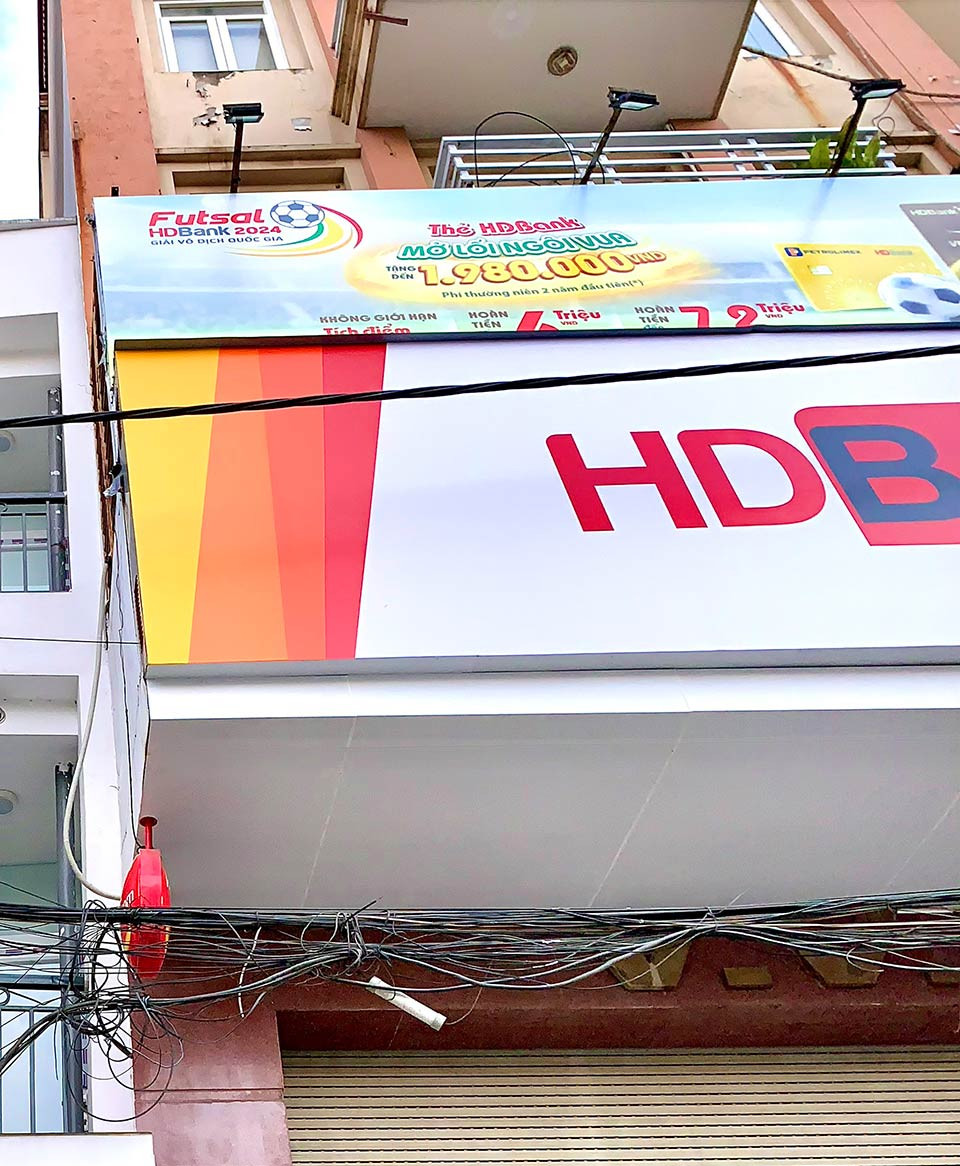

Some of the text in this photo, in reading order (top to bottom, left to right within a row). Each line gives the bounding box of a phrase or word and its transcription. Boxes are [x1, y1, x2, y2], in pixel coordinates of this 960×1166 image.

[148, 208, 266, 227] Futsal
[148, 225, 282, 238] HDBank 2024
[479, 217, 585, 236] HDBank
[399, 231, 632, 259] MỞ LỐI NGÔI VUA
[417, 250, 636, 287] 1.980.000
[467, 309, 509, 319] HOÀN
[552, 308, 601, 322] Triệu
[633, 305, 675, 315] HOÀN
[754, 302, 805, 315] Triệu
[319, 311, 438, 324] KHÔNG GIỚI HẠN
